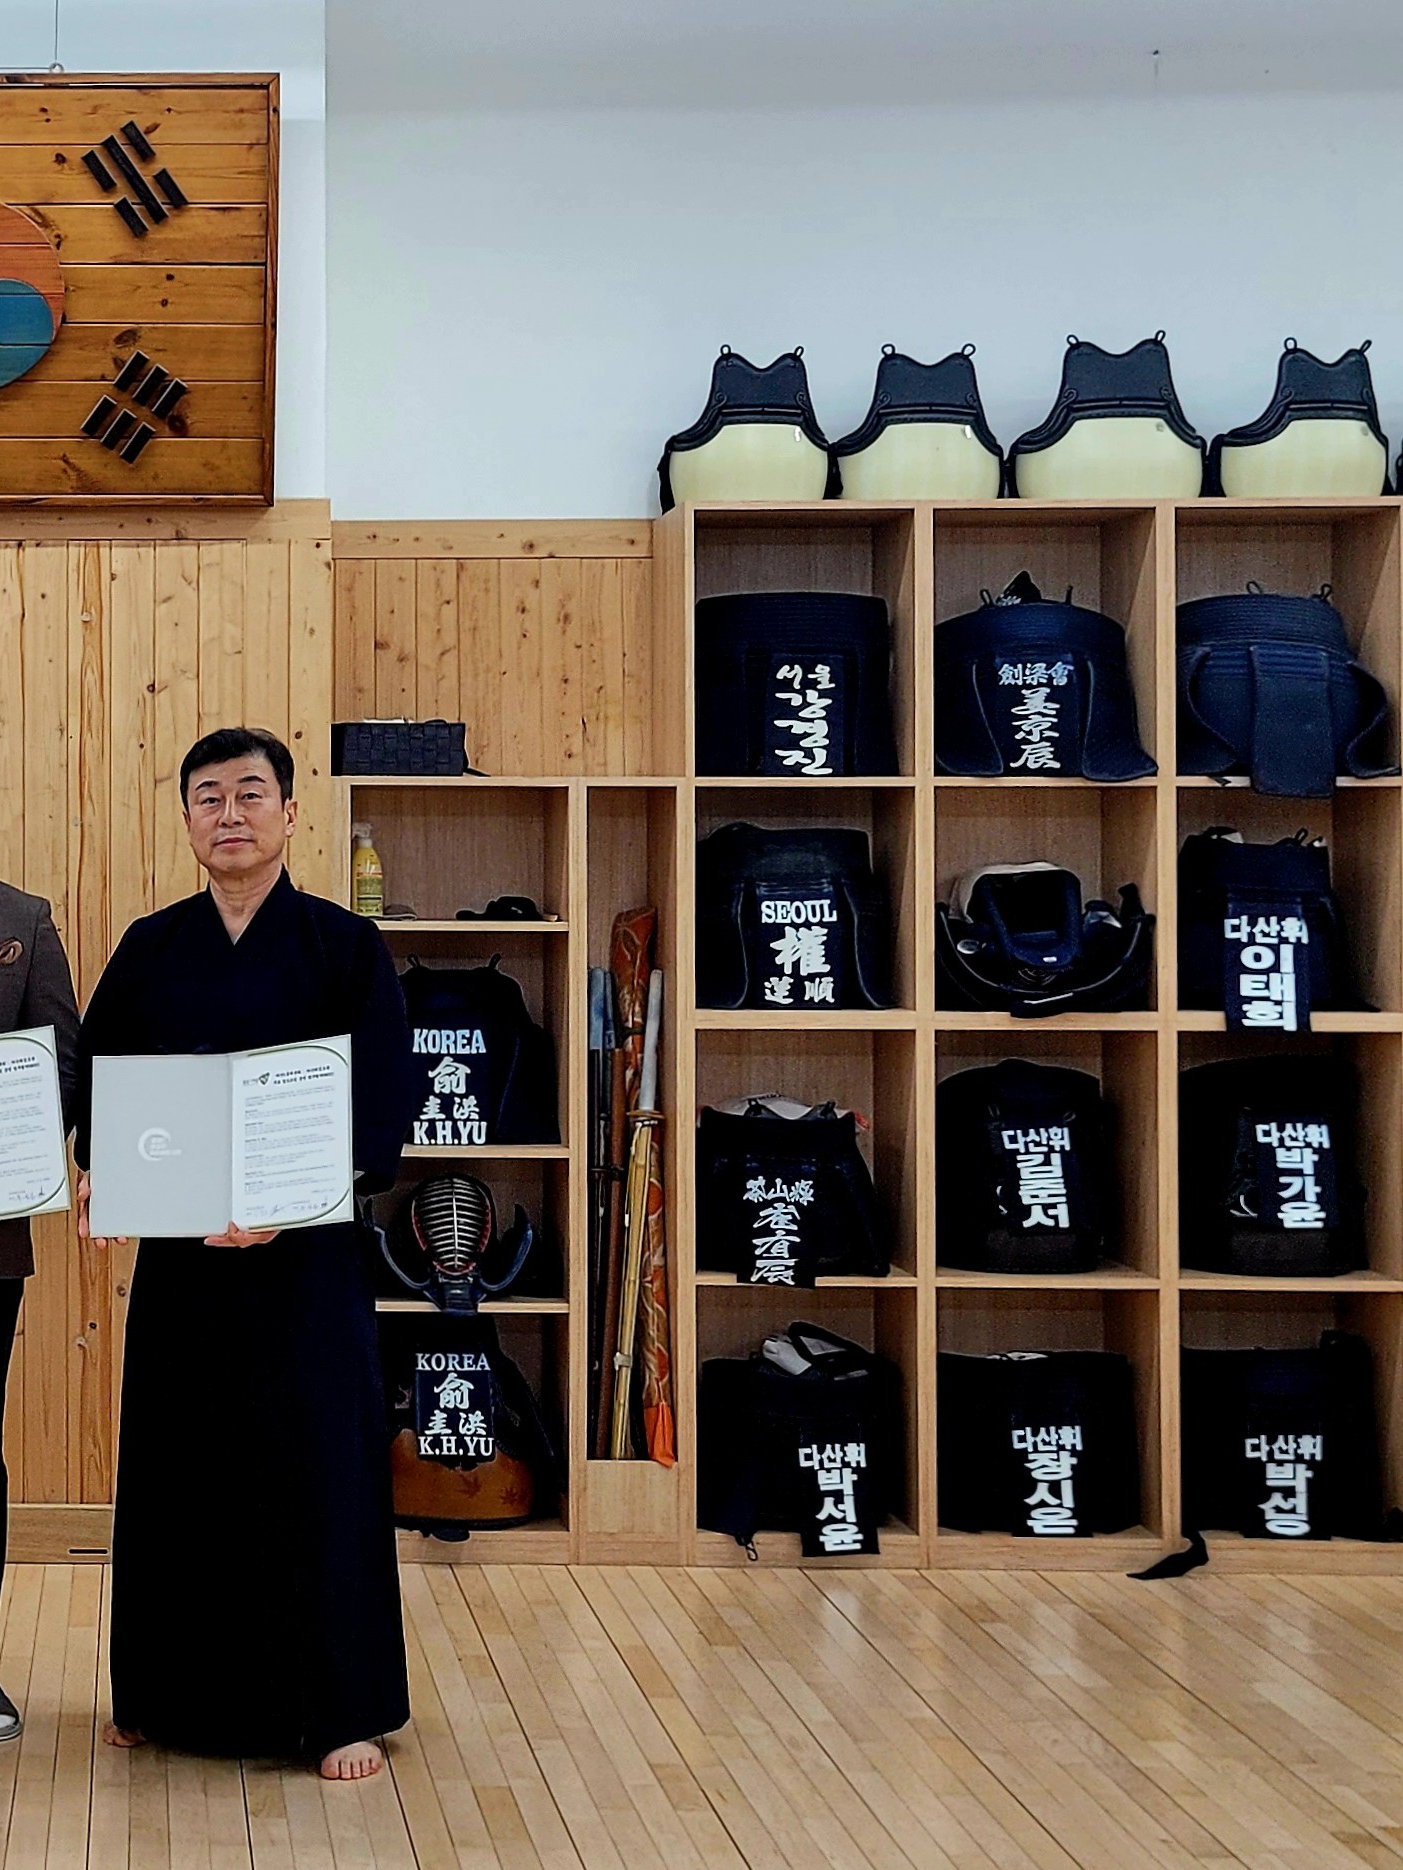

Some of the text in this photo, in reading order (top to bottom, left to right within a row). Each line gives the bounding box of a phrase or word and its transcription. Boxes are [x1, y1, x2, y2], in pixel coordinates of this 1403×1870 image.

[775, 663, 836, 690] 서울
[774, 689, 834, 777] 강경진
[760, 899, 838, 924] SEOUL
[1224, 915, 1309, 947] 다산휘
[769, 925, 831, 978] 權
[1241, 943, 1299, 1032] 이태희
[412, 1028, 487, 1055] KOREA
[413, 1121, 488, 1146] K.H.YU
[1255, 1122, 1330, 1150] 다산휘
[1016, 1149, 1070, 1228] 김준서
[1274, 1148, 1328, 1229] 박가윤
[416, 1353, 491, 1372] KOREA
[418, 1435, 494, 1458] K.H.YU
[1012, 1425, 1083, 1455] 다산휘
[1245, 1434, 1322, 1462] 다산휘
[798, 1442, 867, 1470] 다산휘
[1023, 1452, 1082, 1535] 장시온
[815, 1469, 864, 1552] 박서윤
